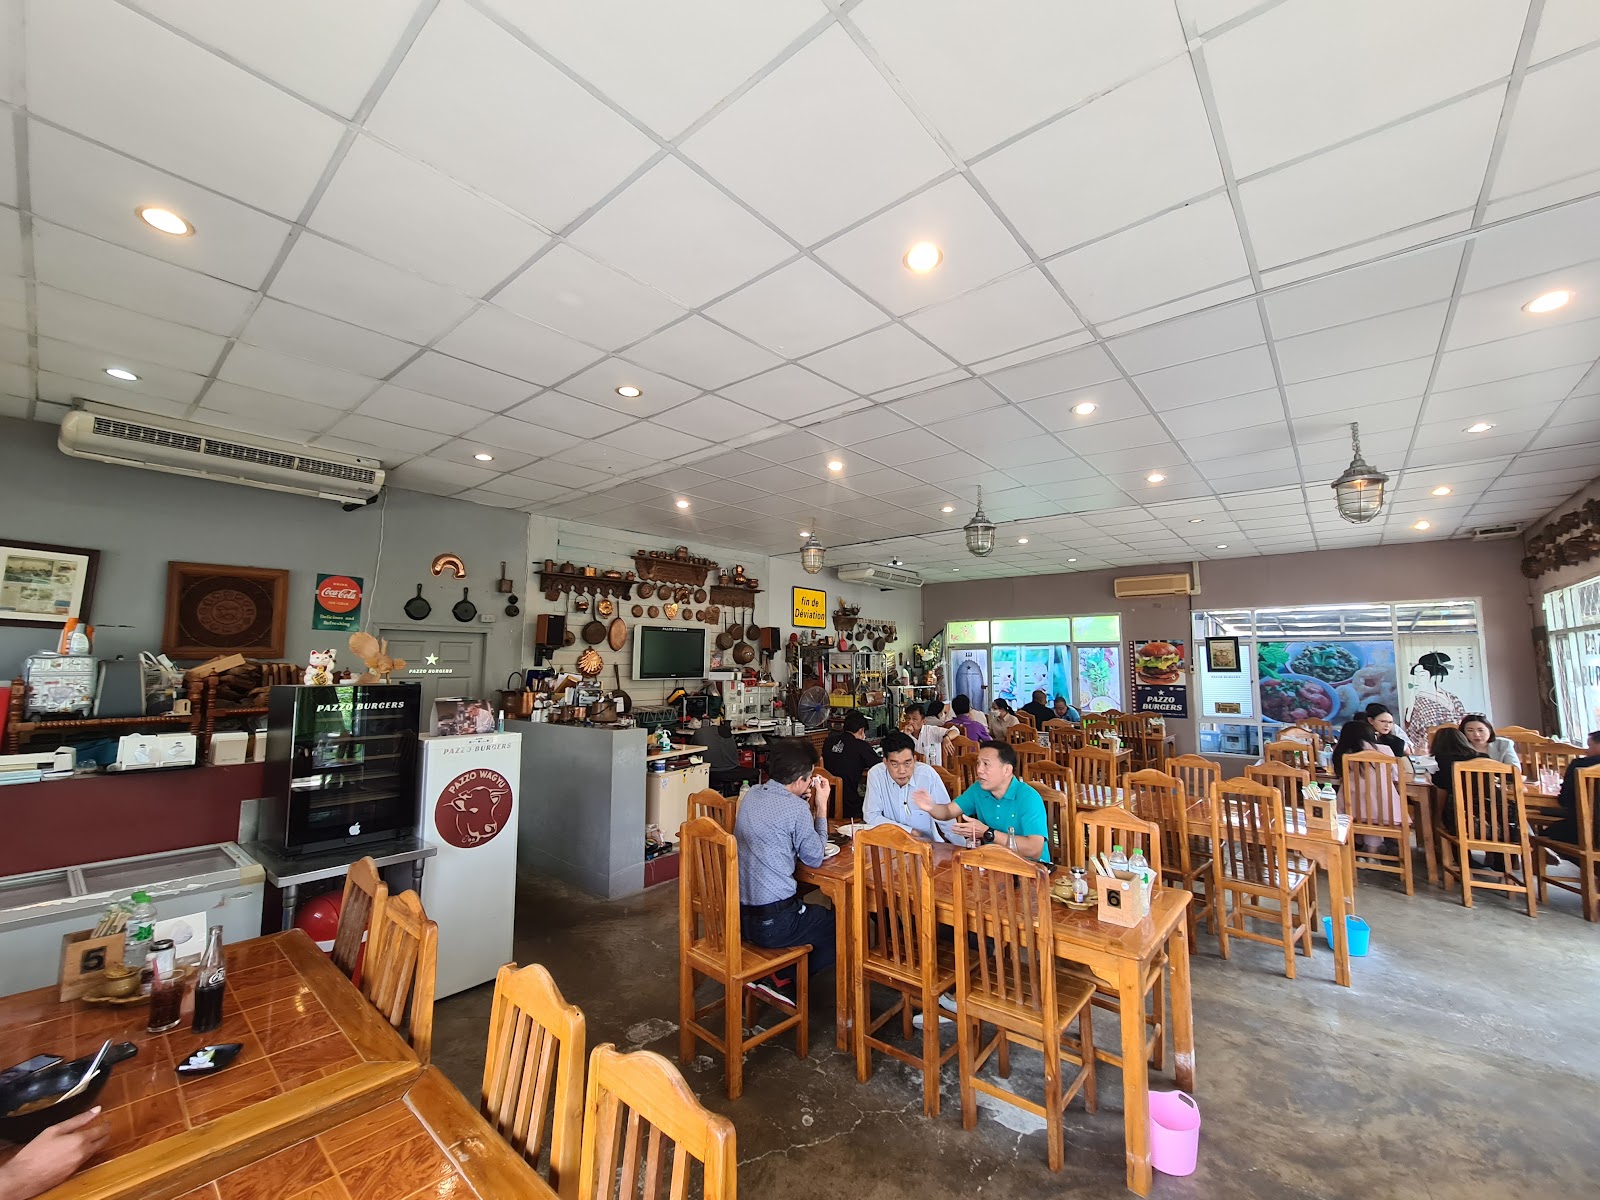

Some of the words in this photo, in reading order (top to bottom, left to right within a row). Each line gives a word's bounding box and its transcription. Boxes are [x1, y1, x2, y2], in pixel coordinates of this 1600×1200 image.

[801, 596, 810, 606] fin
[812, 598, 819, 607] de
[794, 608, 825, 621] Déviation
[323, 620, 351, 628] Refreshing
[1146, 696, 1176, 704] PAZZO
[316, 703, 354, 712] PAZZO
[355, 701, 405, 711] BURGERS
[1142, 703, 1183, 711] BURGERS
[448, 771, 477, 794] PAZZO
[479, 770, 506, 789] WAGYU
[1107, 889, 1120, 907] 6
[84, 949, 104, 971] 5
